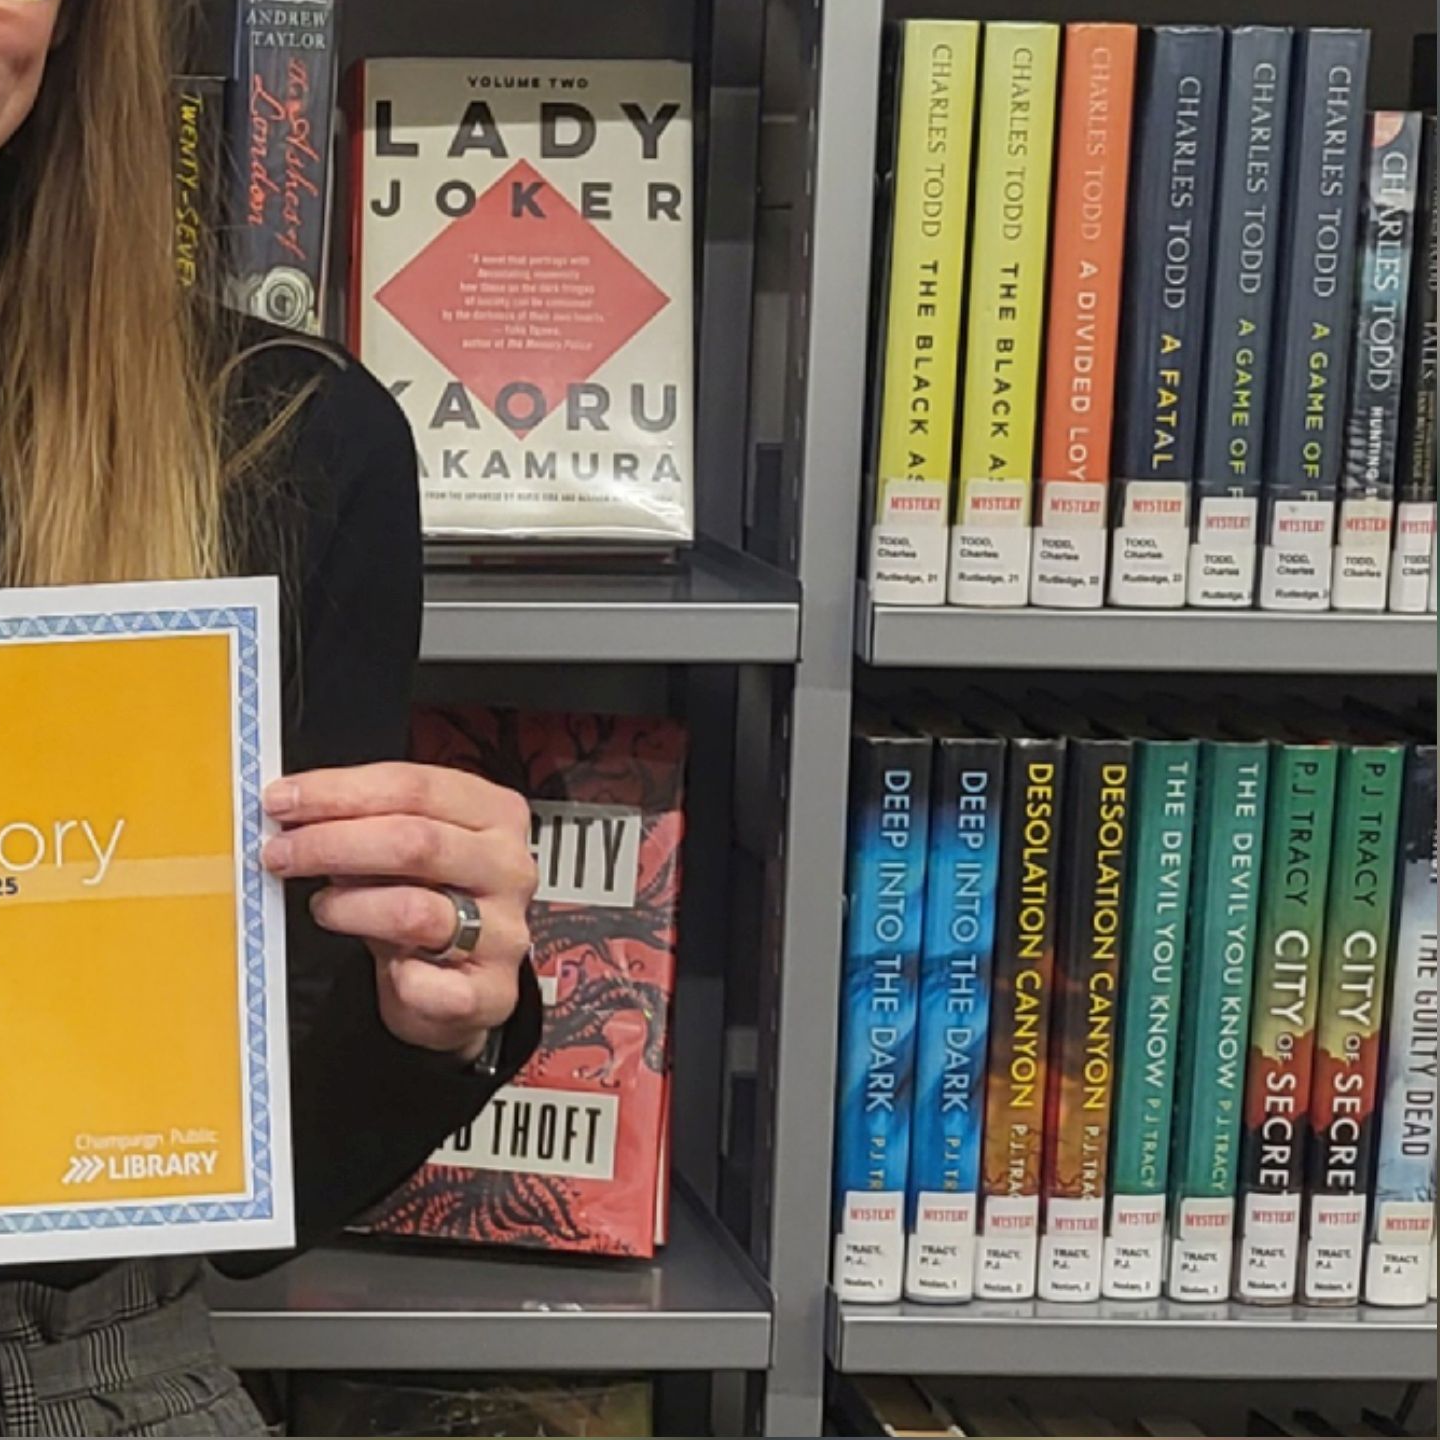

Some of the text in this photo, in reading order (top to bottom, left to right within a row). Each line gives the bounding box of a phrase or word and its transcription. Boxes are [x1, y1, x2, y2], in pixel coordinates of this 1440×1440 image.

[245, 9, 326, 28] ANDREW
[251, 31, 326, 50] TAYLOR
[374, 100, 680, 160] LADY
[467, 76, 589, 90] VOLUME TWO
[370, 179, 682, 221] JOKER
[908, 44, 952, 436] CHARLES TODD THE BLACK
[1229, 62, 1276, 475] CHARLES TODD A GAME OF
[1367, 151, 1408, 392] CHARLES TODD
[1070, 291, 1098, 414] DIVIDED
[1152, 334, 1182, 471] A FATAL
[890, 497, 941, 511] MYSTERY
[877, 548, 918, 559] Charles
[866, 770, 911, 1113] DEEP INTO THE DARK
[1009, 763, 1054, 1108] DESOLATION CANYON
[1145, 762, 1189, 1089] THE DEVIL YOU KNOW
[1270, 812, 1314, 1063] TRACY CITY OF
[1402, 991, 1434, 1157] GUILTY DEAD
[75, 1128, 219, 1152] Champaign Public
[108, 1151, 218, 1180] LIBRARY
[491, 1096, 602, 1164] THOFT
